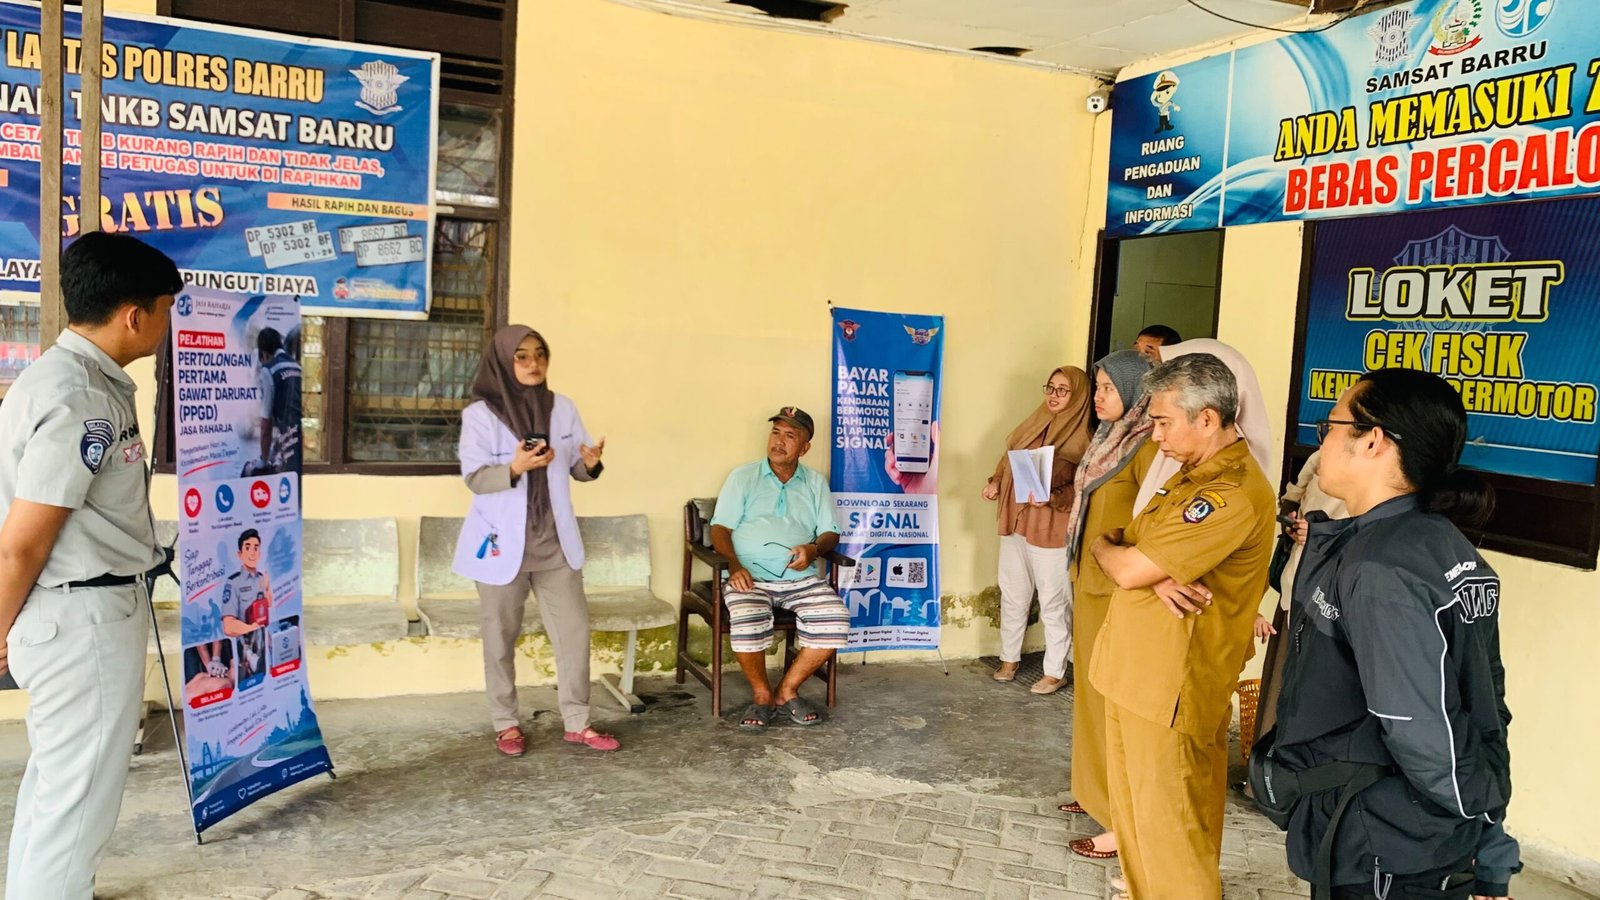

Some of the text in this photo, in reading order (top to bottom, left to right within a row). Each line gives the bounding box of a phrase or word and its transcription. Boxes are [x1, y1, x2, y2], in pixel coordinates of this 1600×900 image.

[124, 45, 228, 92] POLRES
[234, 58, 325, 103] BARRU
[1366, 41, 1547, 93] SAMSAT BARRU
[1276, 107, 1358, 161] ANDA
[1368, 64, 1575, 147] MEMASUKI
[169, 102, 291, 141] SAMSAT
[299, 116, 394, 151] BARRU
[1141, 136, 1185, 156] RUANG
[119, 135, 190, 156] KURANG
[195, 144, 244, 160] RAPIH
[249, 148, 280, 164] DAN
[284, 151, 330, 169] TIDAK
[333, 156, 384, 177] JELAS,
[121, 155, 198, 174] PETUGAS
[202, 162, 260, 180] UNTUK
[262, 166, 279, 182] DI
[283, 171, 360, 189] RAPIHKAN
[1124, 157, 1200, 181] PENGADUAN
[1146, 183, 1172, 200] DAN
[1285, 154, 1397, 214] BEBAS
[291, 197, 414, 217] HASIL RAPIH DAN BAGUS
[1124, 203, 1192, 224] INFORMASI
[247, 222, 315, 243] DP 5302 BF
[341, 230, 353, 244] DP
[263, 235, 331, 255] DP 5302 BF
[357, 245, 369, 258] DP
[264, 277, 316, 294] BIAYA
[1347, 264, 1561, 319] LOKET
[179, 334, 224, 347] PELATIHAN
[179, 351, 252, 367] PERTOLONGAN
[1366, 331, 1526, 378] CEK FISIK
[179, 369, 227, 384] PERTAMA
[838, 366, 889, 382] BAYAR
[179, 386, 257, 401] GAWAT DARURAT
[838, 381, 889, 397] PAJAK
[837, 396, 890, 407] KENDARAAN
[179, 404, 218, 423] (PPGD)
[837, 406, 889, 417] BERMOTOR
[180, 423, 233, 436] JASA RAHARJA
[837, 417, 890, 427] TAHUNAN
[837, 427, 890, 436] DI APLIKASI
[837, 436, 890, 449] SIGNAL
[837, 499, 928, 508] DOWNLOAD SEKARANG
[849, 512, 919, 529] SIGNAL
